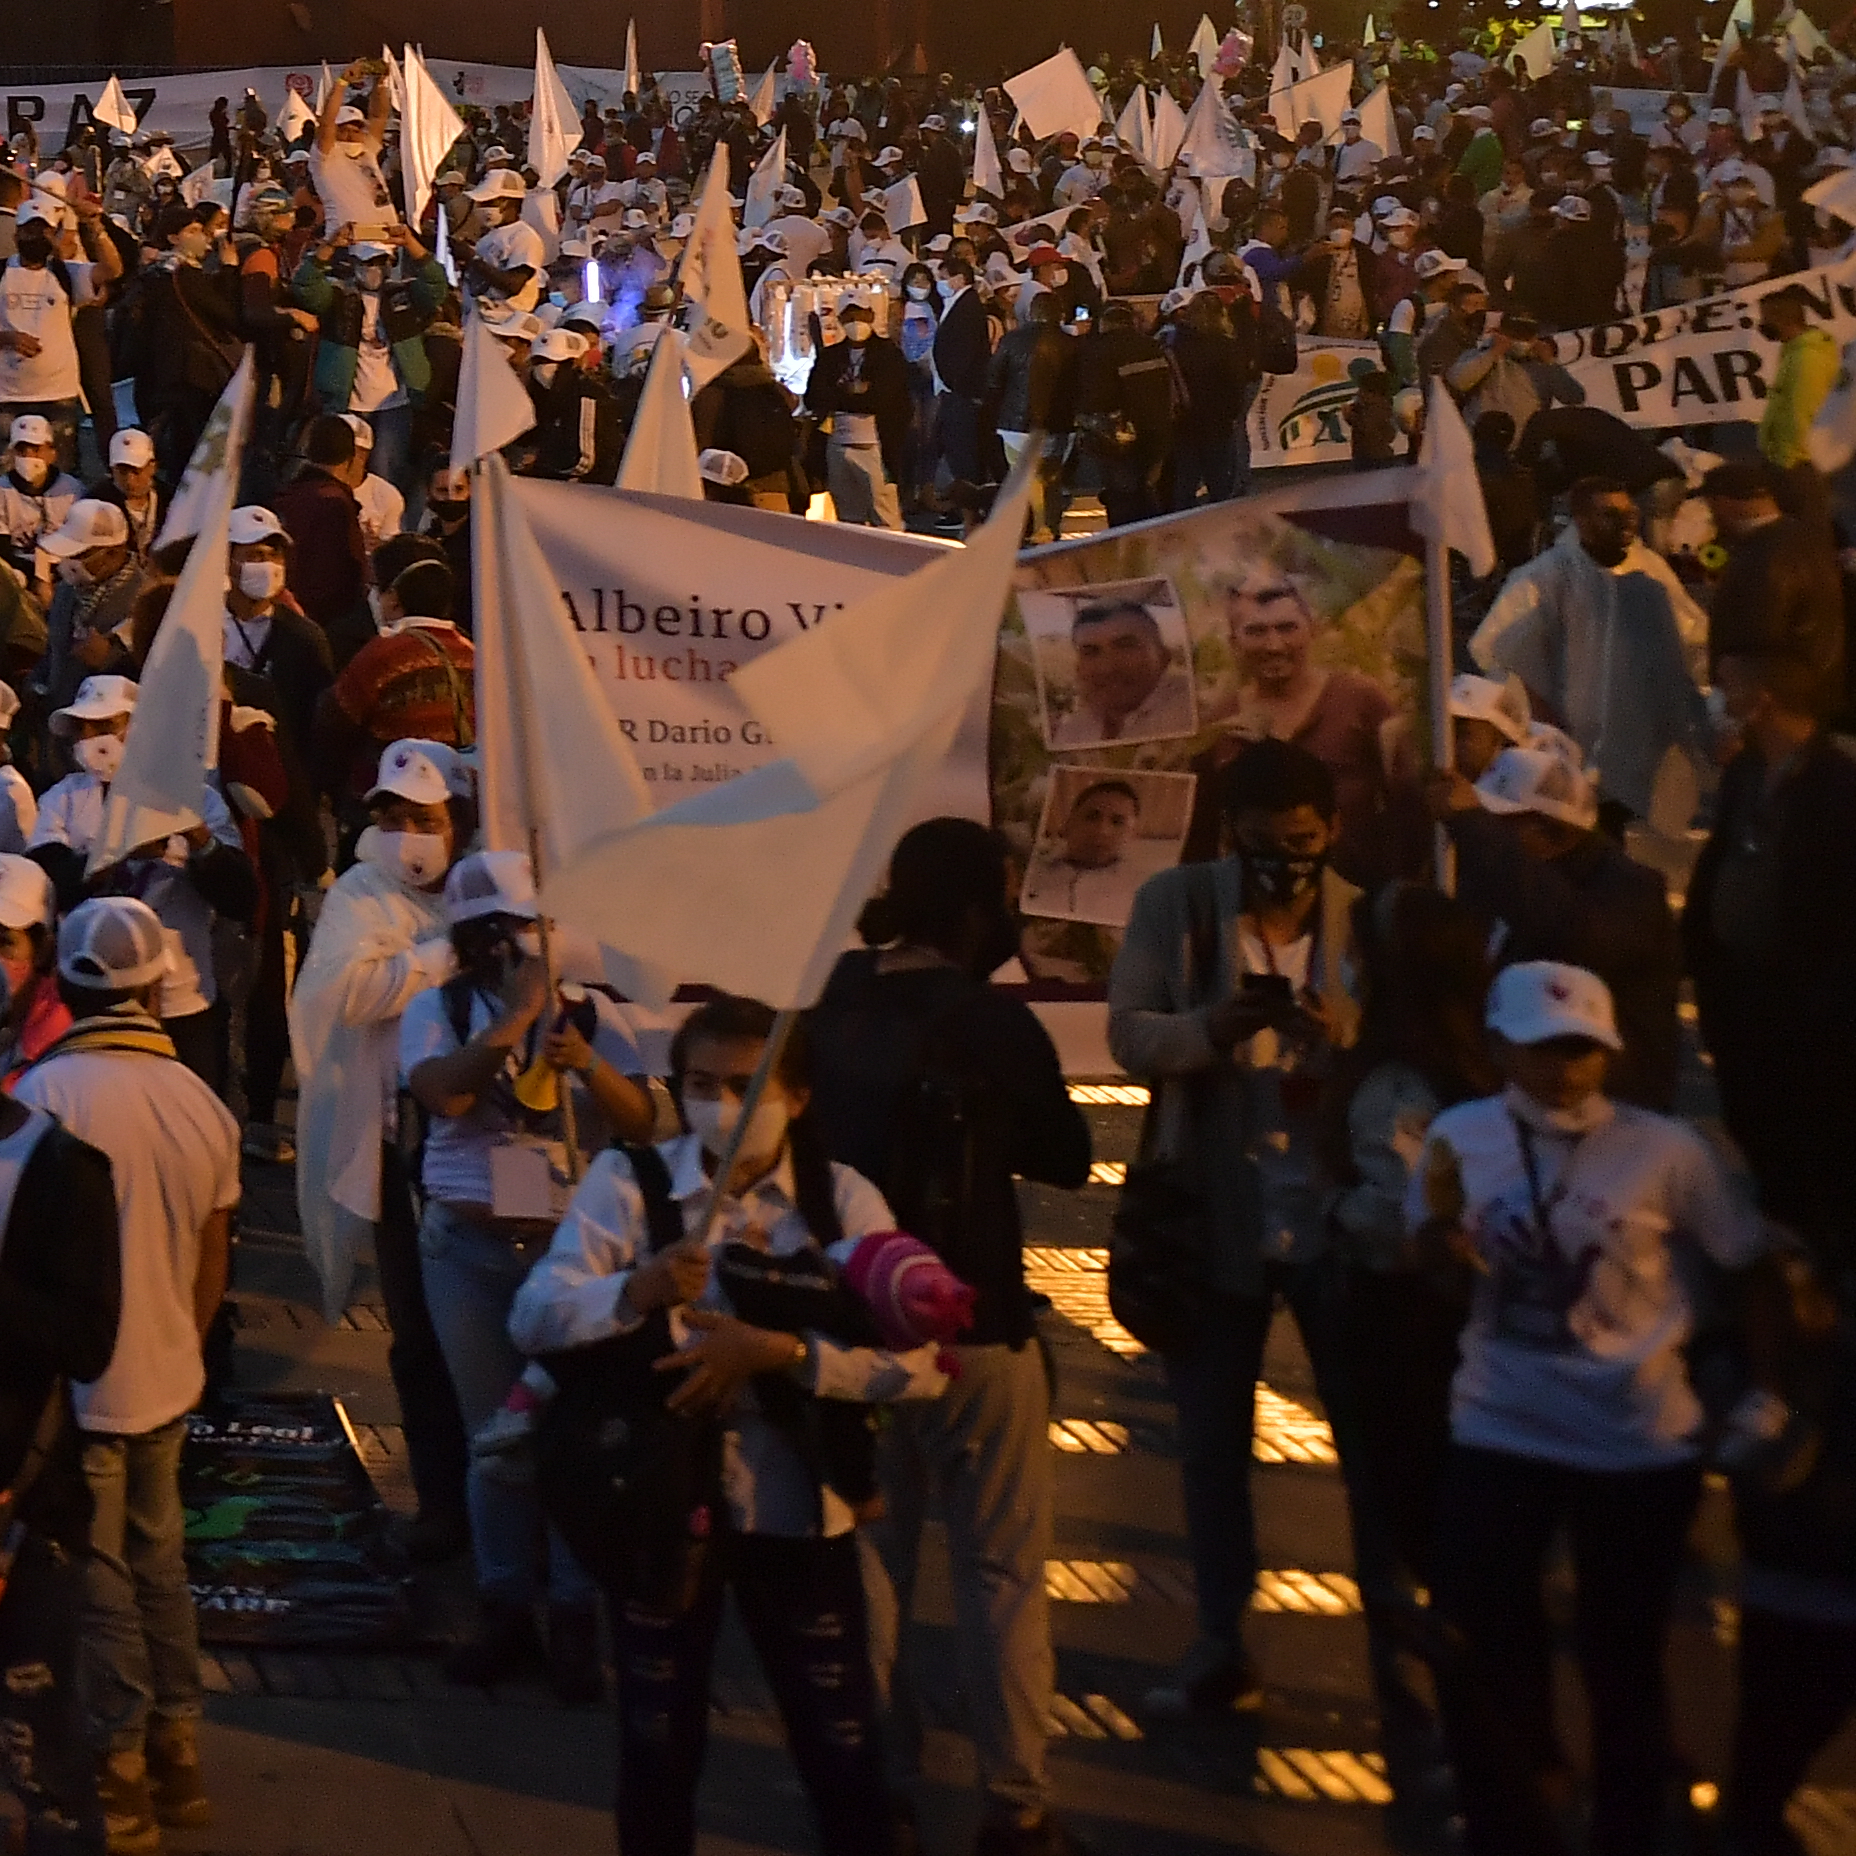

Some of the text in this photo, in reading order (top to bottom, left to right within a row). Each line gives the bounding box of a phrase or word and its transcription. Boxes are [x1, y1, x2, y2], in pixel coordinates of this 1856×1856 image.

[6, 87, 158, 149] PAZ
[562, 588, 770, 642] Albeiro
[647, 718, 732, 745] Dario
